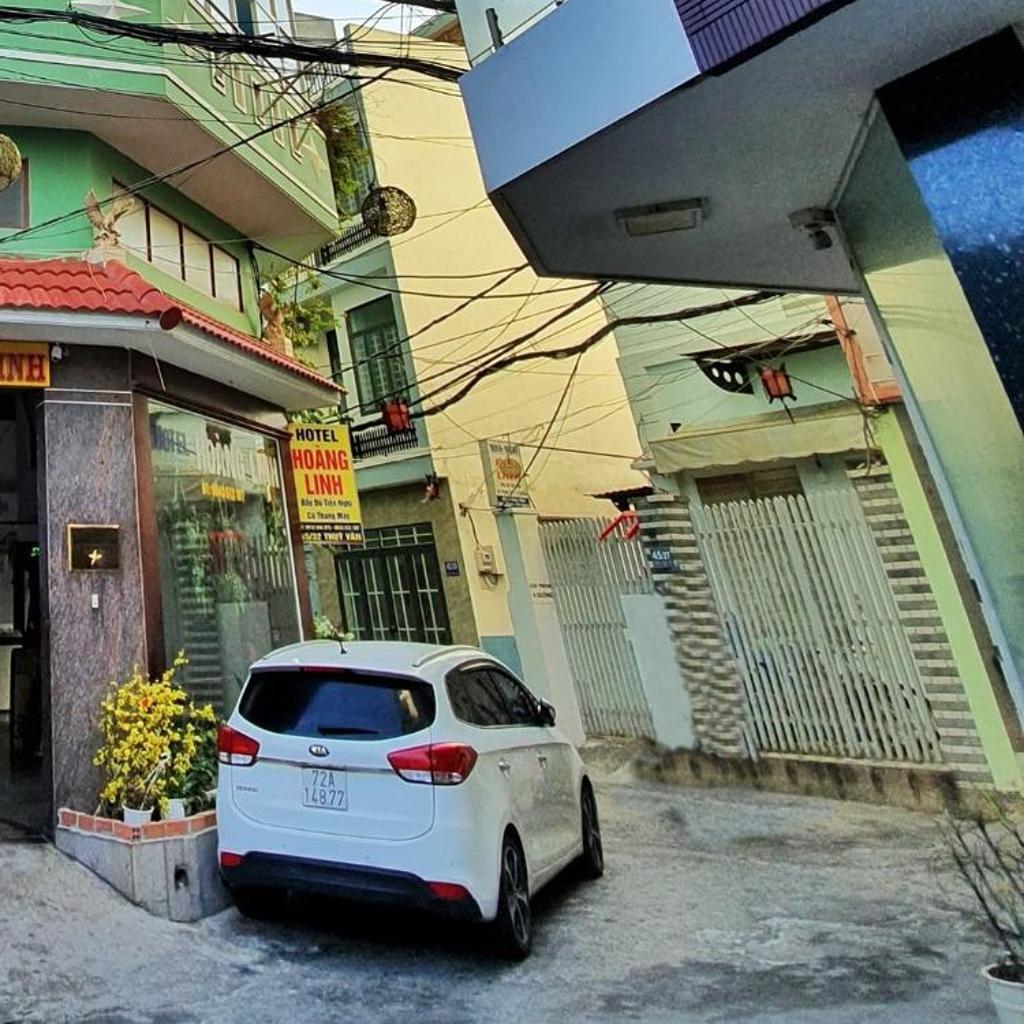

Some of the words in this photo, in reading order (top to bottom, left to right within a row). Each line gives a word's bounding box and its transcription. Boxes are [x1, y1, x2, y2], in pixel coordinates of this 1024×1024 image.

[296, 428, 338, 443] HOTEL
[304, 474, 344, 495] LINH
[312, 770, 335, 787] 72A
